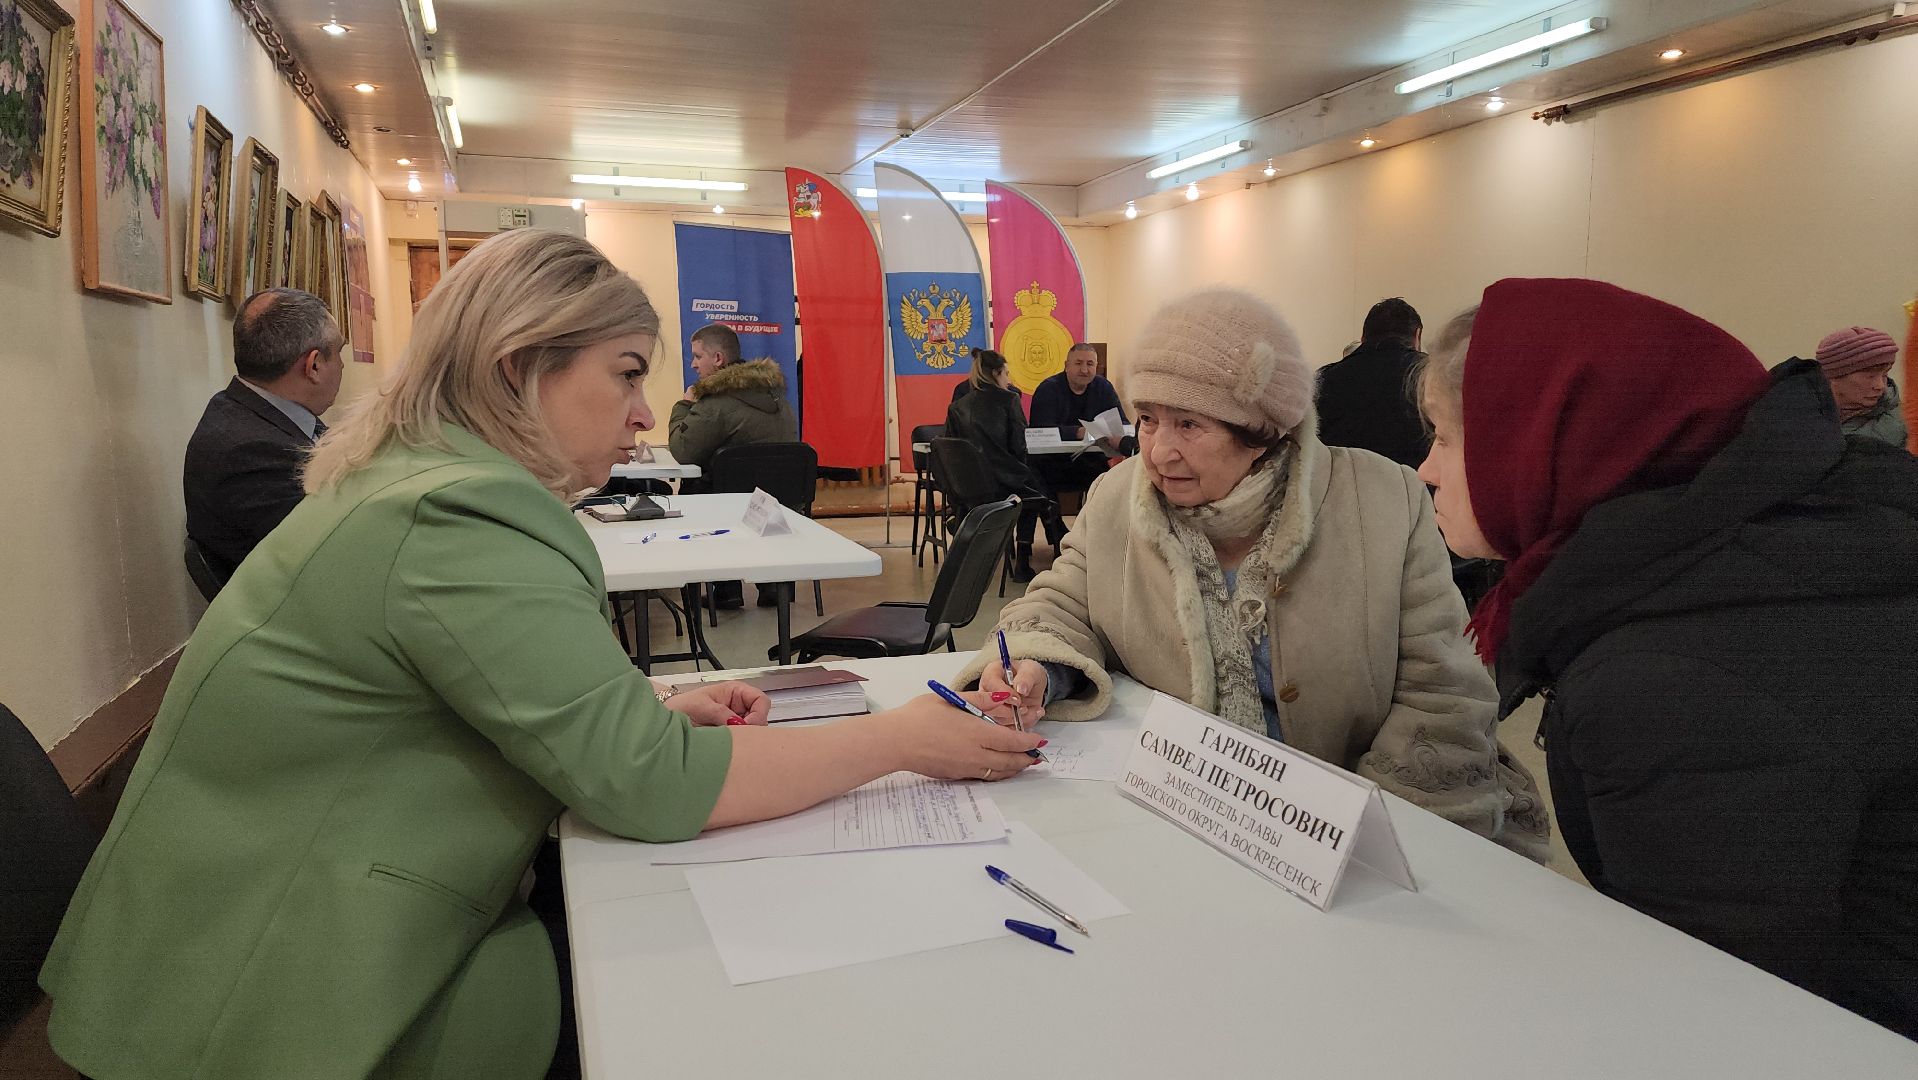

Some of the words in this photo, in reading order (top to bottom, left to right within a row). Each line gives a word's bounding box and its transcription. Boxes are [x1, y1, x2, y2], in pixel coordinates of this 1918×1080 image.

[695, 302, 735, 310] ГОРДОСТЬ
[705, 313, 759, 322] УВЕРЕННОСТЬ
[1200, 726, 1287, 783] ГАРИБЯН
[1140, 730, 1207, 778] САМВЕЛ
[1207, 764, 1344, 851] ПЕТРОСОВИЧ
[1164, 771, 1237, 822] ЗАМЕСТИТЕЛЬ
[1239, 812, 1283, 847] ГЛАВЫ
[1125, 771, 1187, 815] ГОРОДСКОГО
[1188, 808, 1228, 842] ОКРУГА
[1230, 833, 1322, 896] ВОСКРЕСЕНСК
